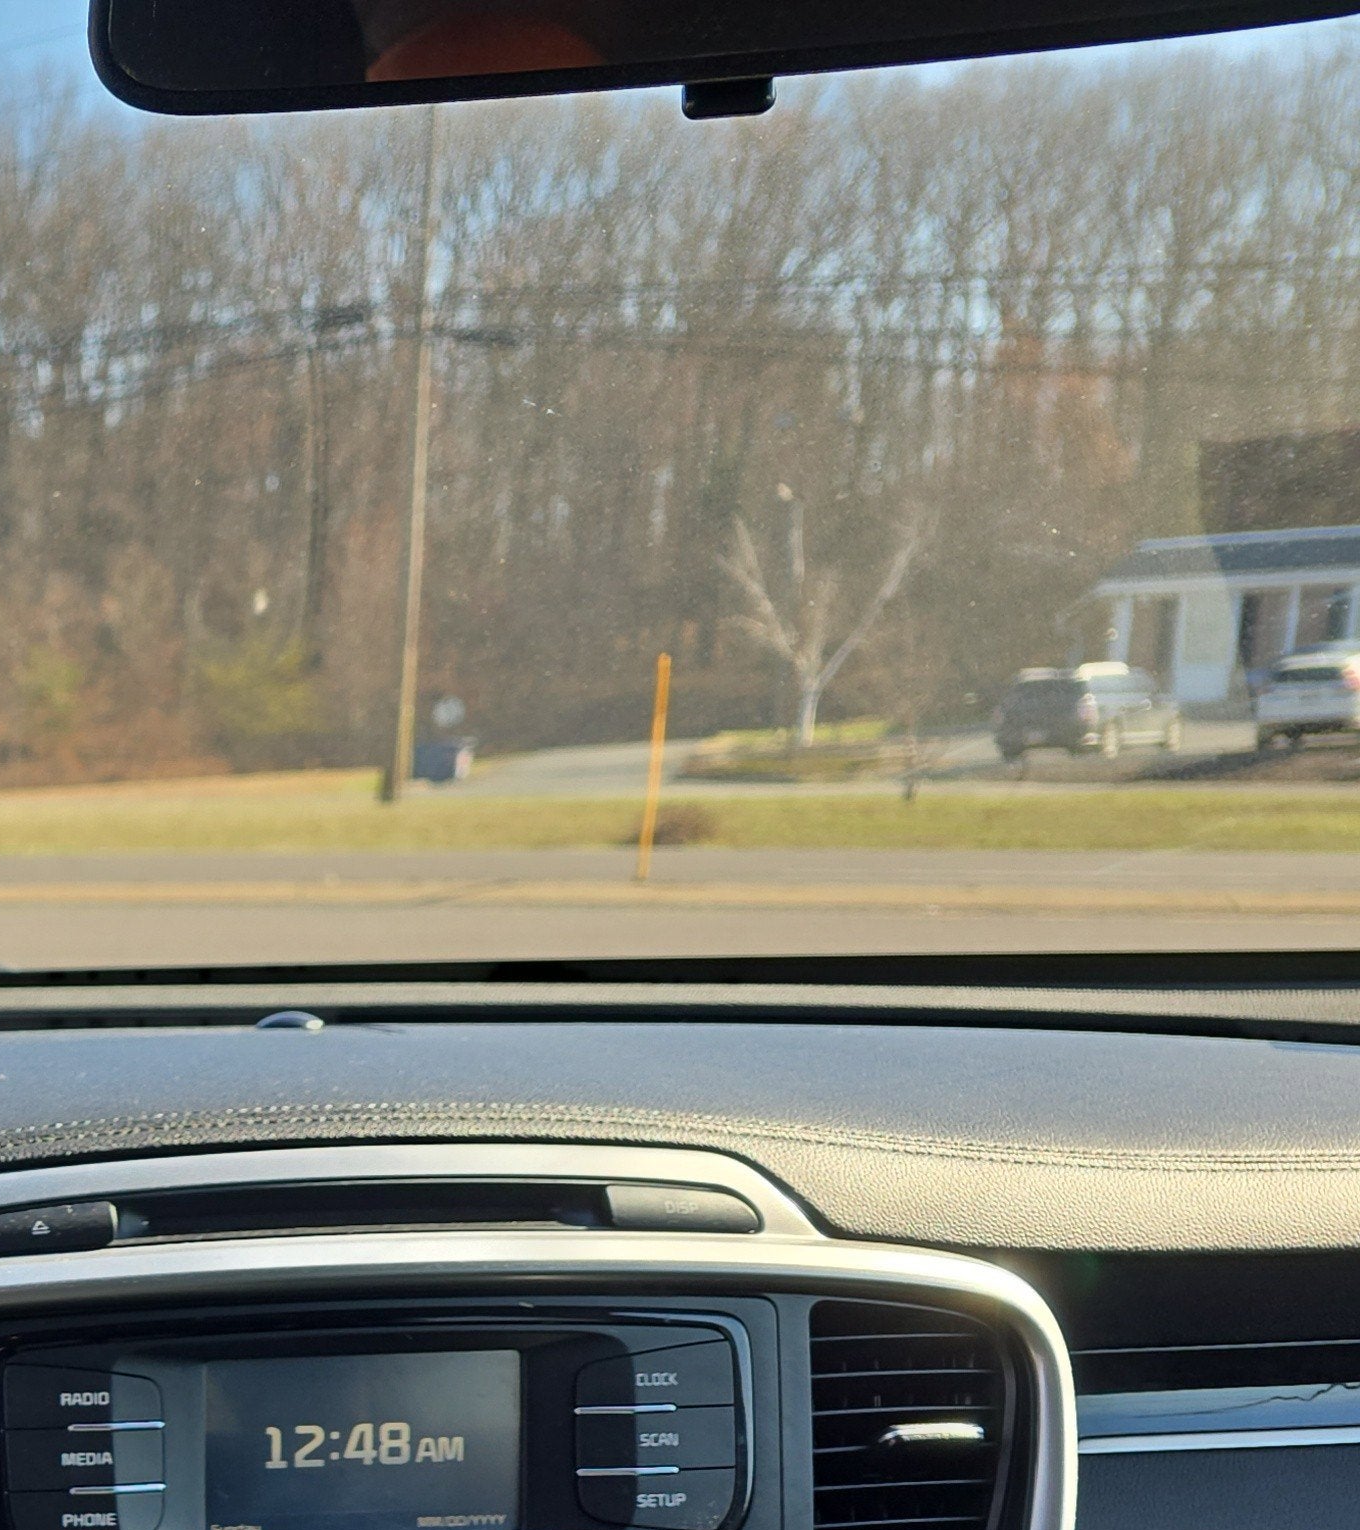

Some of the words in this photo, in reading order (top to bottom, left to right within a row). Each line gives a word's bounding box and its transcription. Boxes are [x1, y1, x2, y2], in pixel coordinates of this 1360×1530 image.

[635, 1372, 678, 1387] CLOCK
[60, 1391, 110, 1406] RADIO
[265, 1422, 411, 1469] 12:48
[415, 1436, 465, 1463] AM
[639, 1432, 680, 1447] SCAN
[61, 1452, 113, 1467] MEDIA
[636, 1492, 687, 1508] SETUP
[62, 1512, 117, 1528] PHONE
